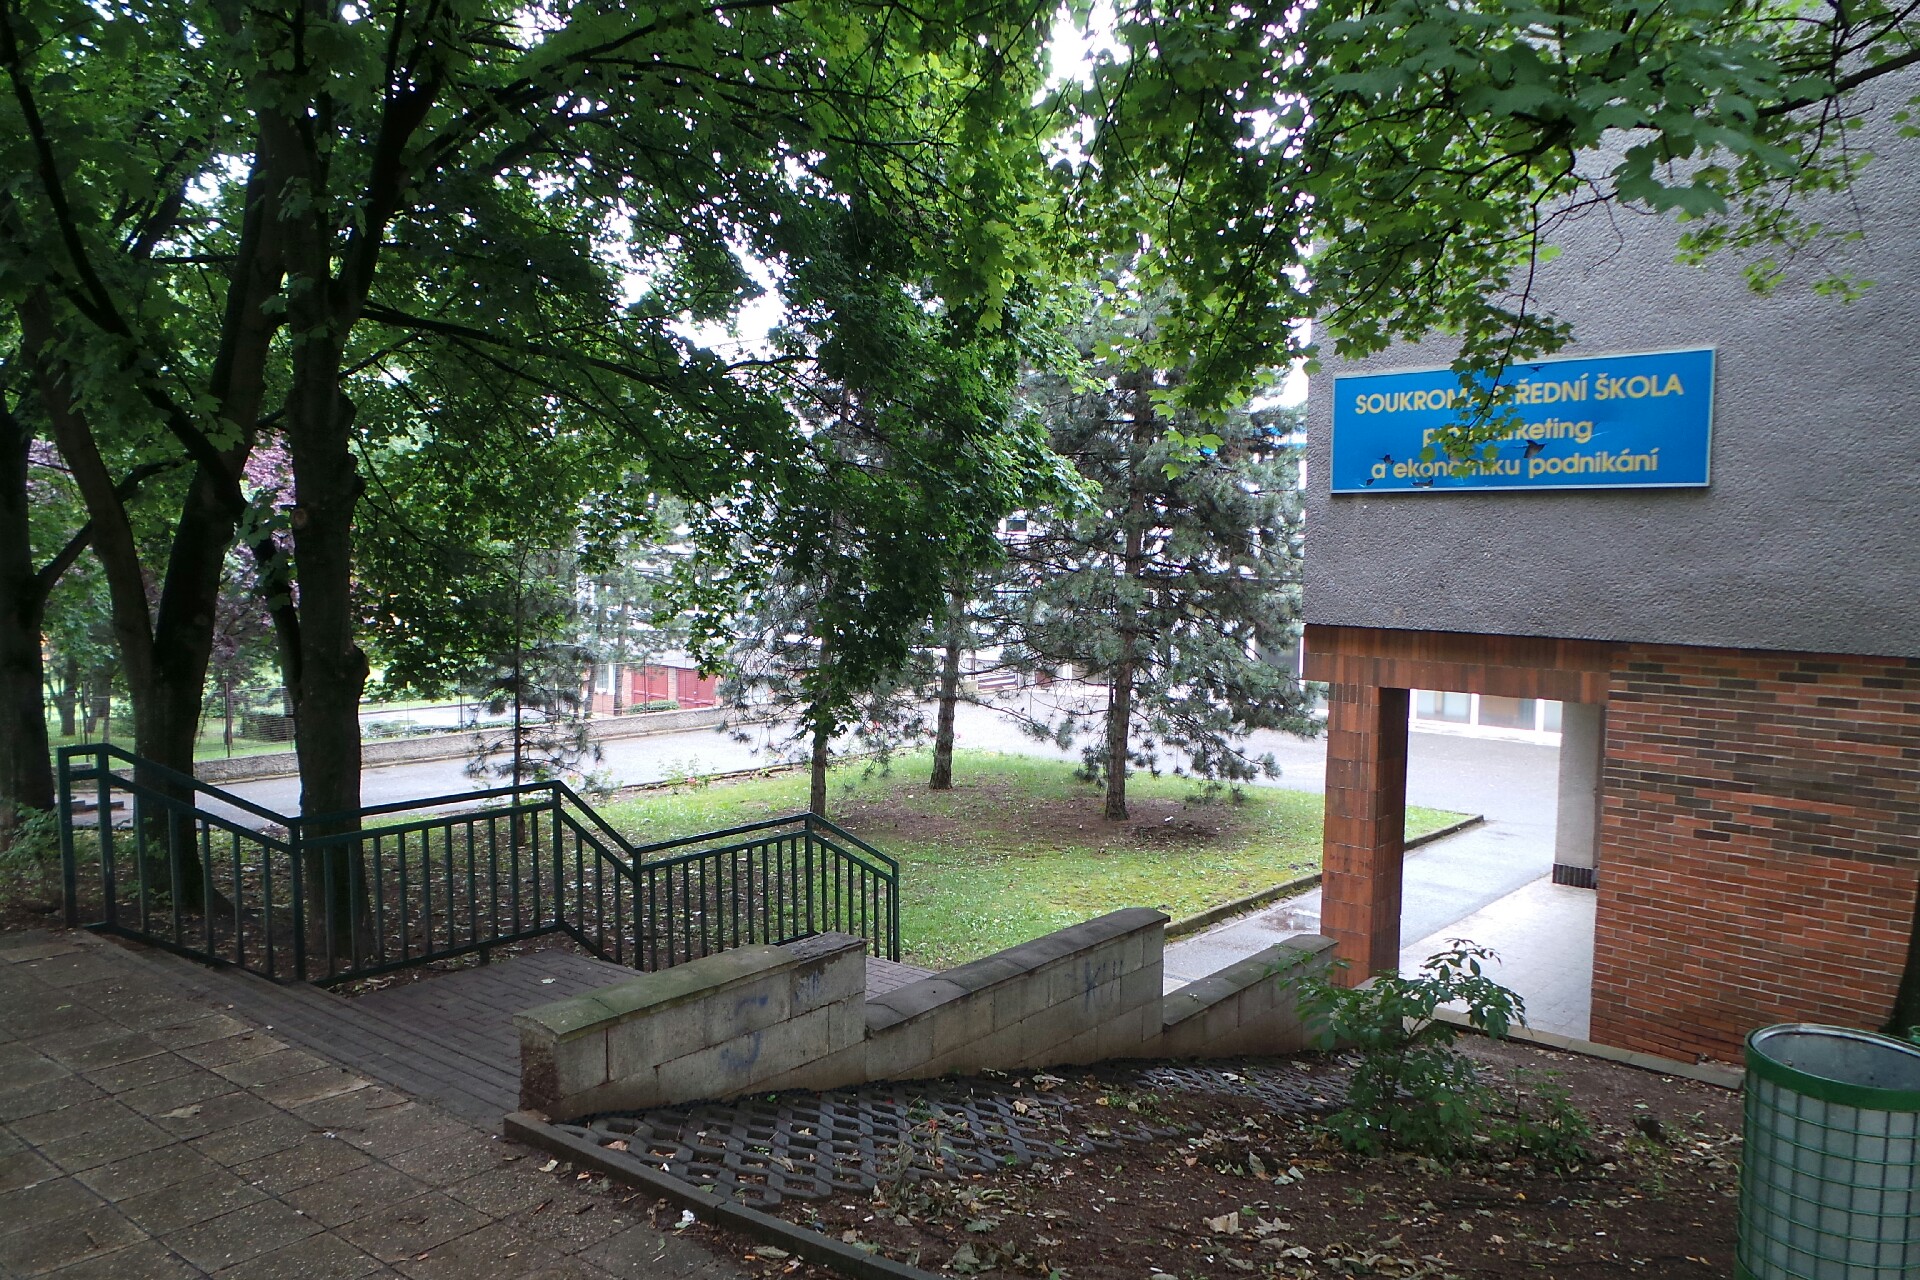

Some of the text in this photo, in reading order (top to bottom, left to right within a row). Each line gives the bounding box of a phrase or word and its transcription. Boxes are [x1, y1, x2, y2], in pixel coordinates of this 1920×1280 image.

[1355, 372, 1684, 414] SOUKROM SŘEDNÍ ŠKOLA
[1371, 463, 1386, 479] a
[1528, 448, 1659, 479] podnikání
